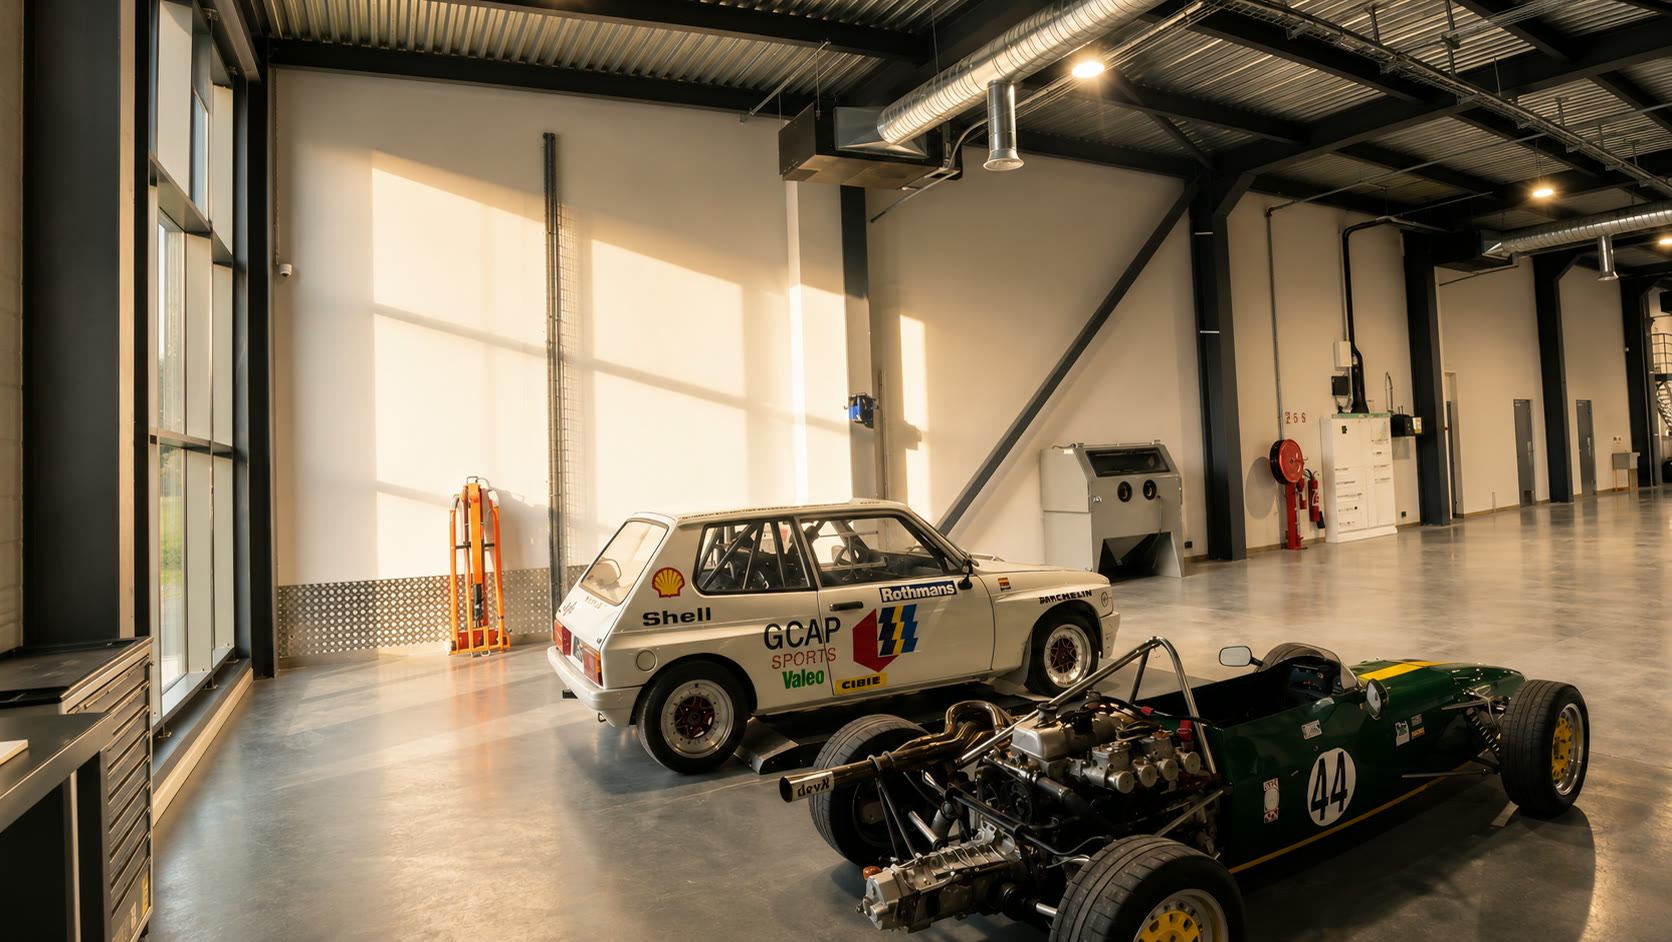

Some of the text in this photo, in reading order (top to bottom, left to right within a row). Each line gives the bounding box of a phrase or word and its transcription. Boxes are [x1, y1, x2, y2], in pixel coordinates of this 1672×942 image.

[881, 584, 955, 602] Rothmans
[642, 607, 712, 626] Shell
[764, 617, 841, 650] GCAP
[772, 647, 837, 669] SPORTS
[782, 669, 825, 689] Valeo
[841, 676, 881, 689] CIBIE
[1310, 751, 1348, 822] 44
